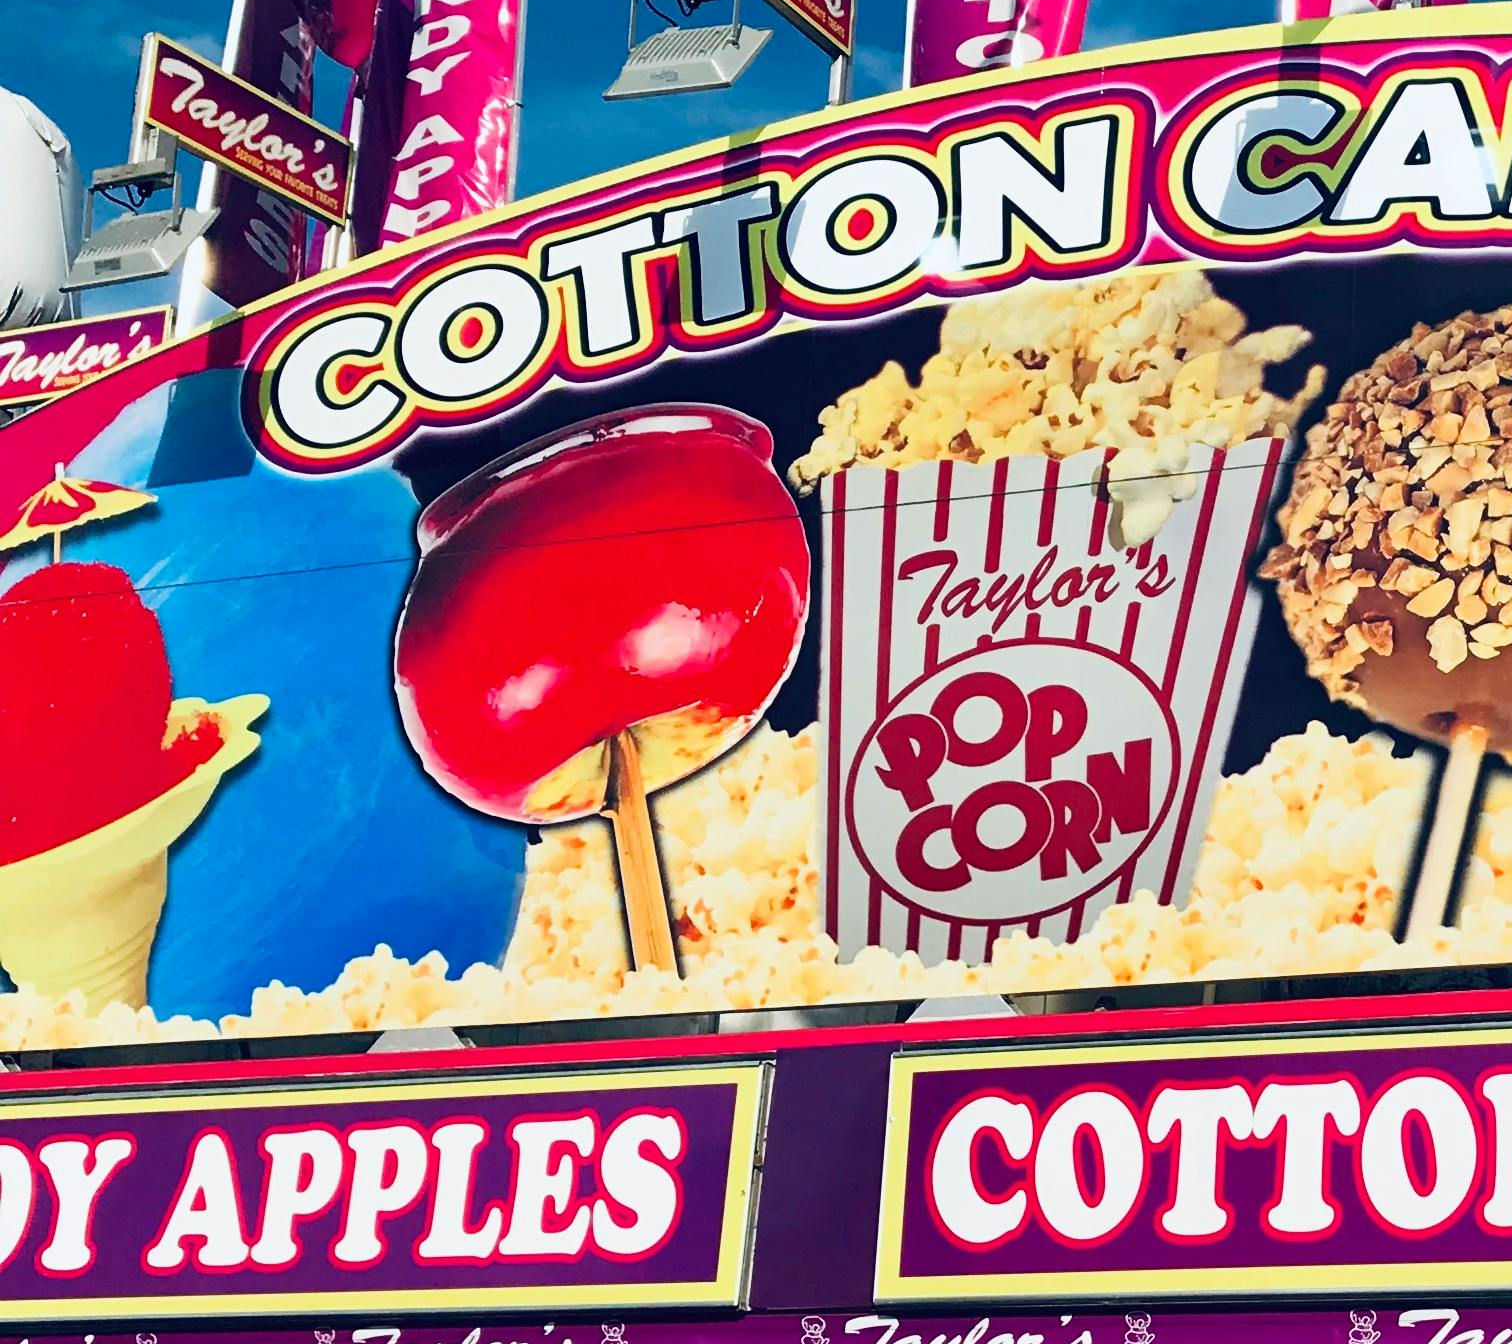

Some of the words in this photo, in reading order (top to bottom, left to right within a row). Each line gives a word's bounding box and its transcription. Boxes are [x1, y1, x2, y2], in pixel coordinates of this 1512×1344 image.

[159, 56, 338, 192] Taylor's
[382, 114, 464, 249] APP
[268, 111, 1122, 453] COTTON
[0, 320, 152, 389] Taylor's
[898, 544, 1177, 635] Taylor's
[873, 671, 1089, 813] POP
[895, 737, 1153, 892] CORN
[144, 1112, 685, 1269] APPLES
